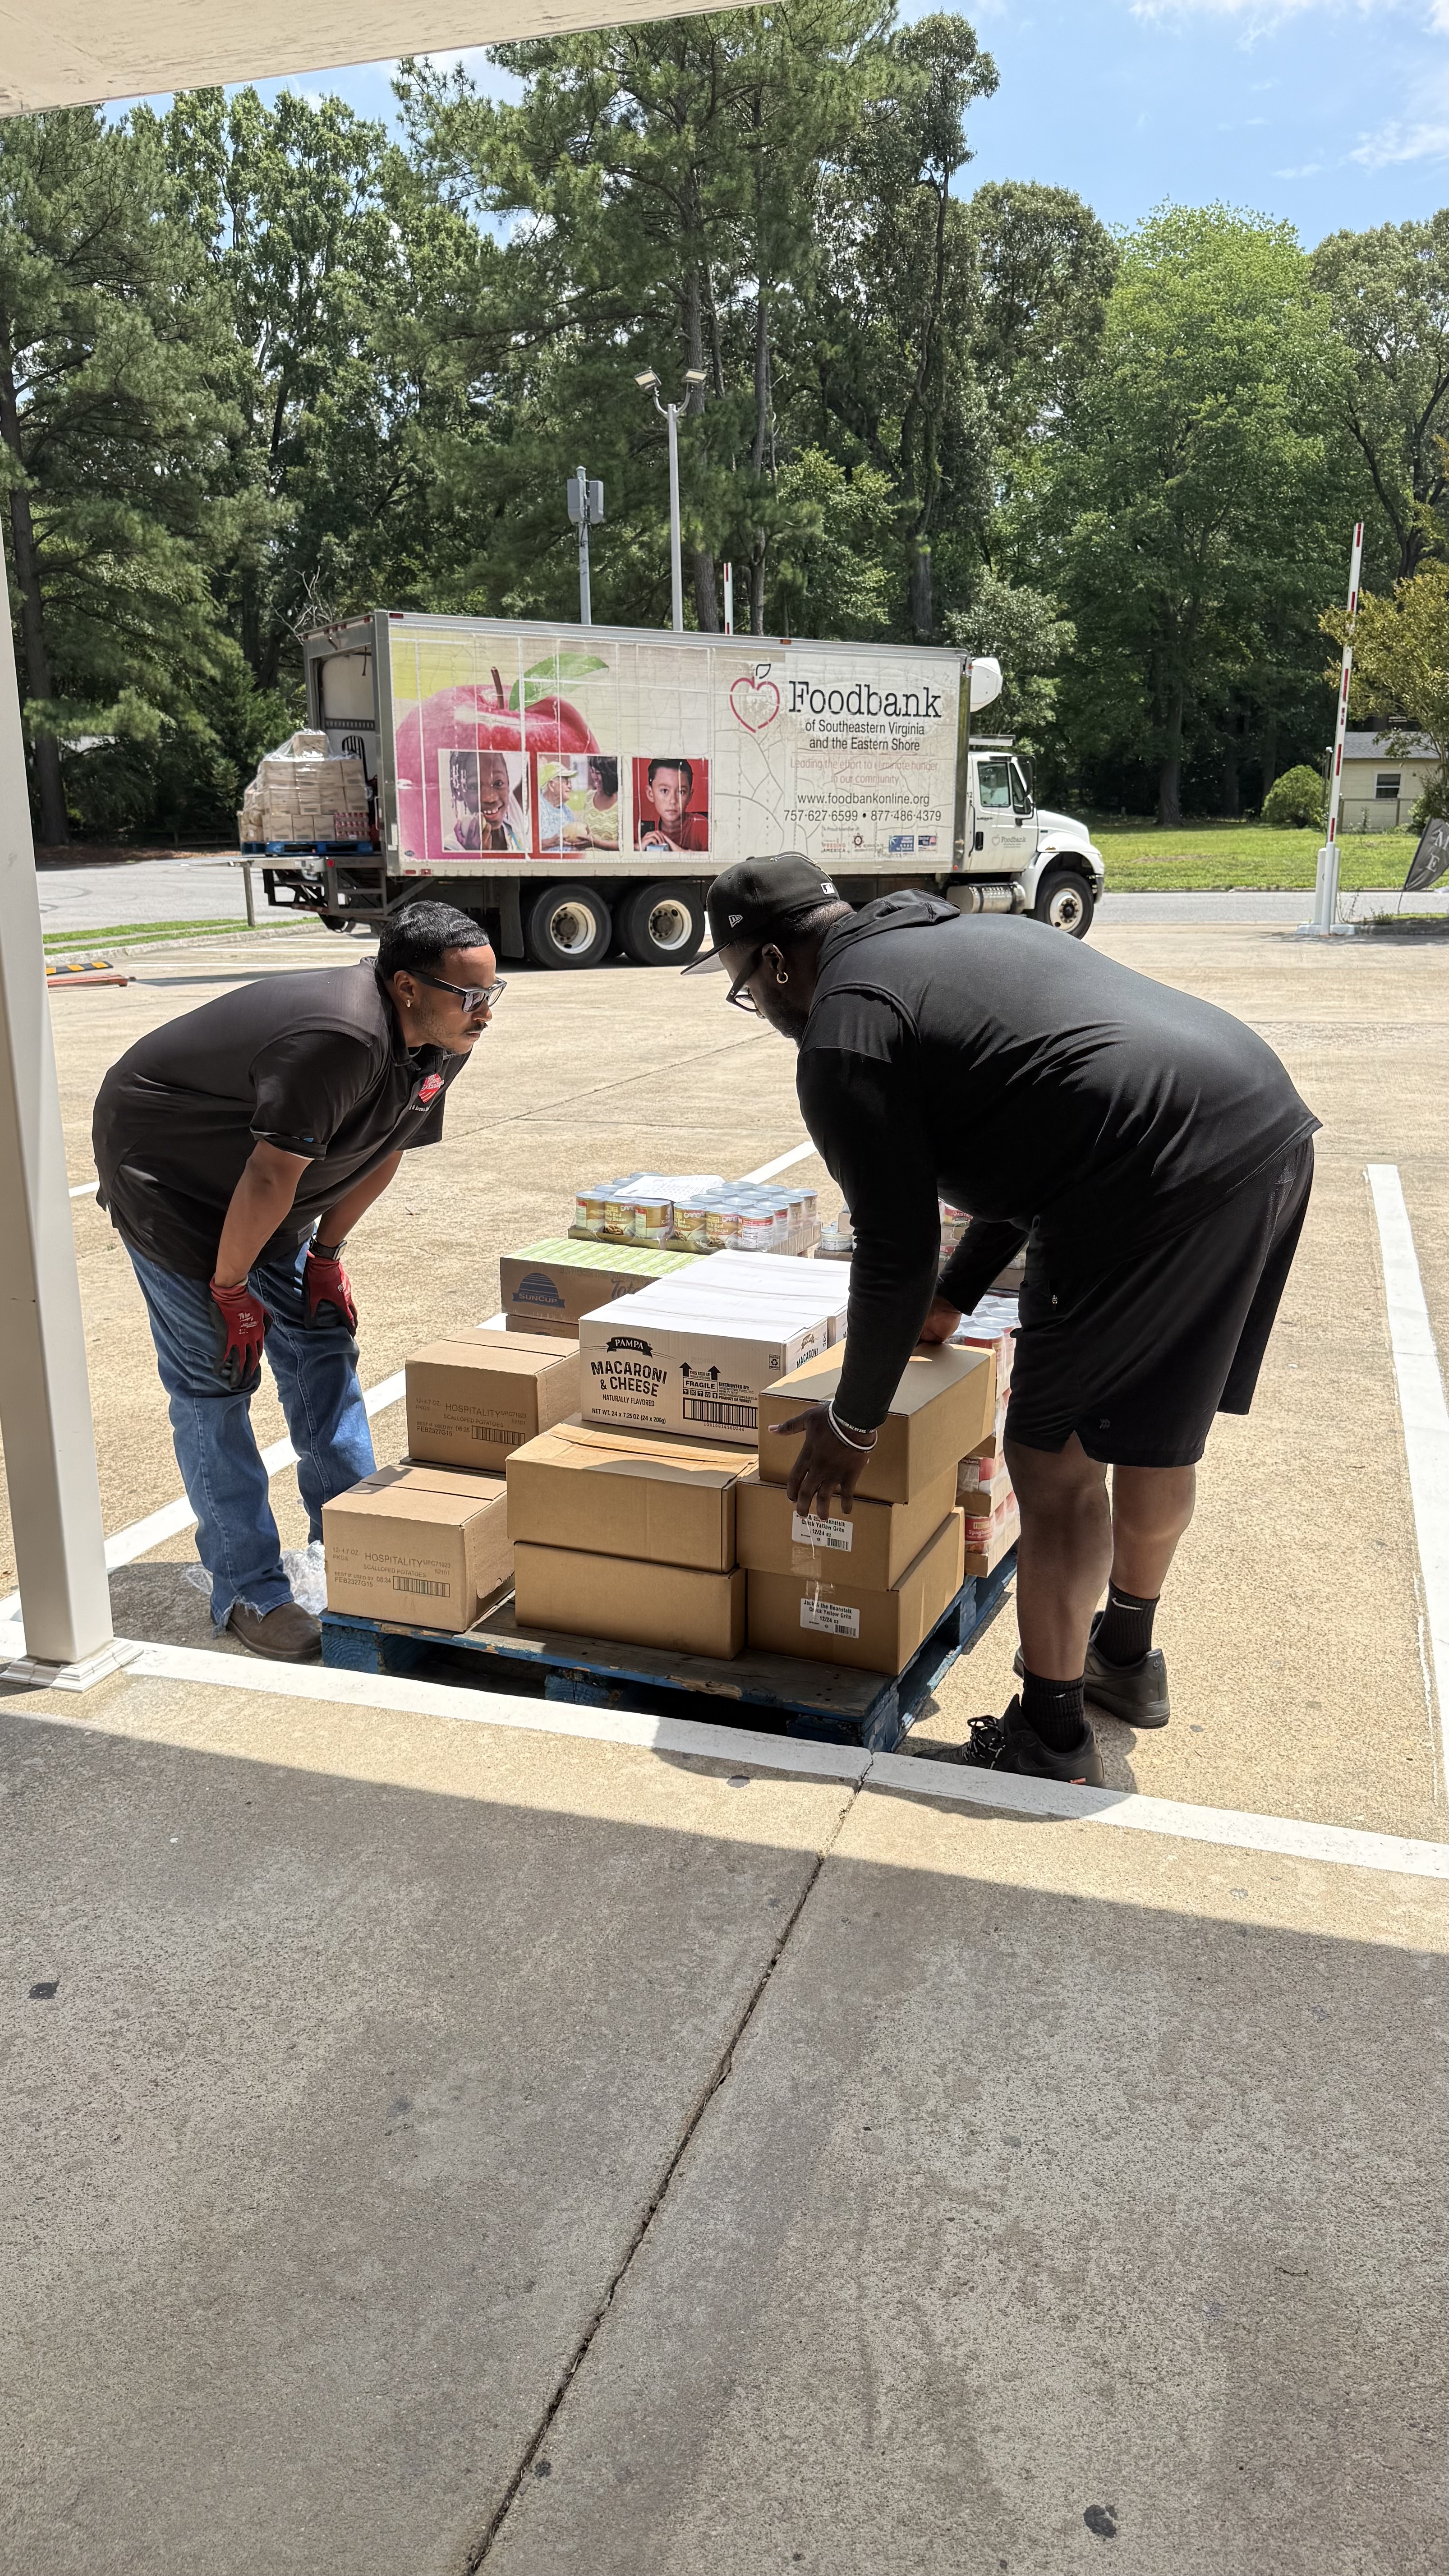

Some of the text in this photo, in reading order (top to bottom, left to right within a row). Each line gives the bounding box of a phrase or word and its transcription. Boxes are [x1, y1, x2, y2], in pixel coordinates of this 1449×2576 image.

[788, 681, 942, 718] Foodbank
[805, 719, 925, 737] of Southeastern Virginia
[810, 737, 920, 751] and the Eastern Shore
[790, 758, 823, 771] Leading
[825, 759, 838, 769] the
[864, 761, 872, 769] to
[911, 761, 938, 773] hunger
[839, 776, 853, 784] our
[855, 775, 899, 786] community
[797, 793, 930, 807] www.foodbankonline.org
[615, 1339, 644, 1350] PAMPA
[590, 1361, 667, 1384] MACARONI
[600, 1376, 659, 1397] & CHEESE
[685, 1380, 715, 1389] FRAGILE
[603, 1394, 655, 1407] NATURALLY FLAVORED
[446, 1403, 501, 1418] HOSPITALITY
[501, 1410, 527, 1419] UPC71923
[444, 1414, 504, 1428] SCALLOPED POTATOES
[653, 1417, 666, 1425] 206g)
[417, 1426, 452, 1436] FEB2327G15
[365, 1552, 423, 1568] HOSPITALITY
[423, 1559, 451, 1568] UPC71923
[363, 1564, 426, 1578] SCALLOPED POTATOES
[335, 1576, 373, 1587] FEB2327G15
[829, 1605, 852, 1614] Beanstalk
